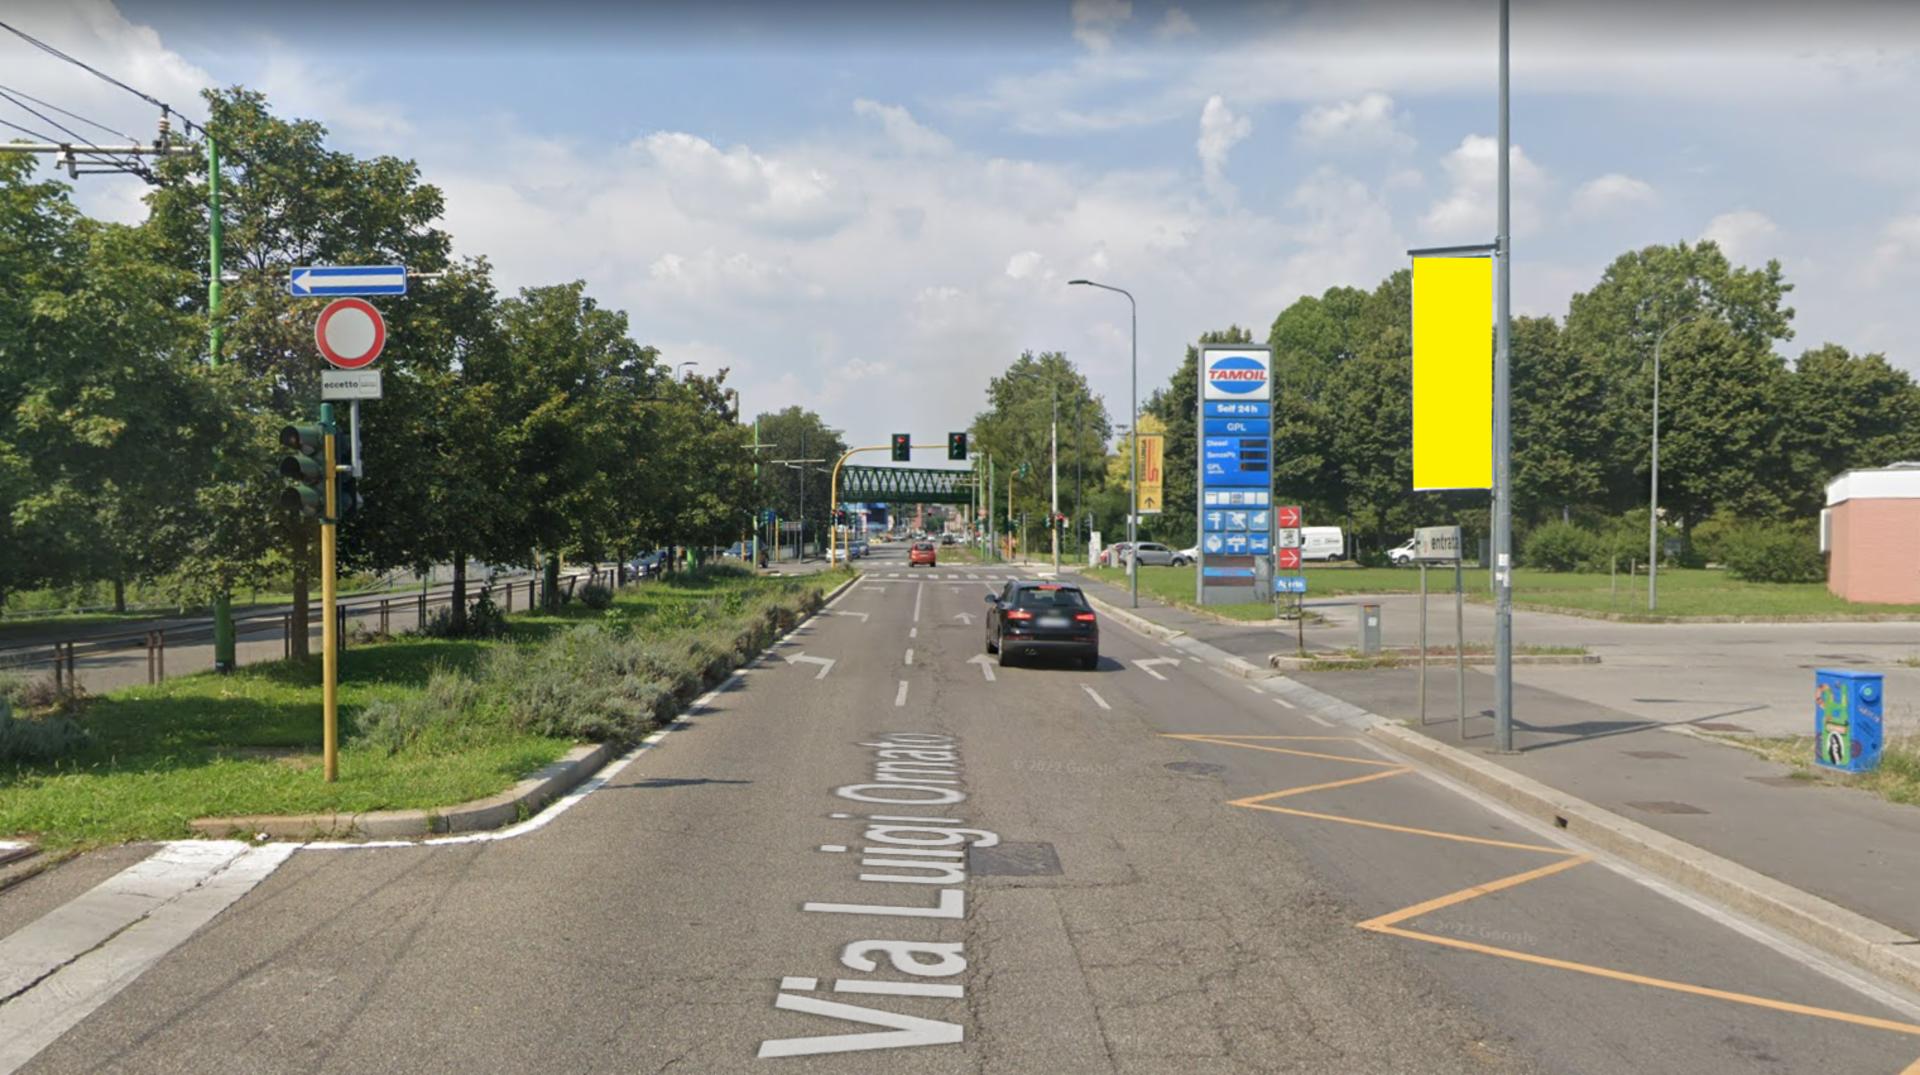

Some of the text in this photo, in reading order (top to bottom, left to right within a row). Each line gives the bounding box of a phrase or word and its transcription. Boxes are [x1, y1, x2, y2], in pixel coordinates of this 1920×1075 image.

[1209, 370, 1267, 379] TAMOIL
[324, 381, 358, 389] eccetto
[1217, 404, 1236, 413] Self
[1227, 423, 1247, 432] GPL
[758, 732, 1000, 1059] Via Luigi Ornato
